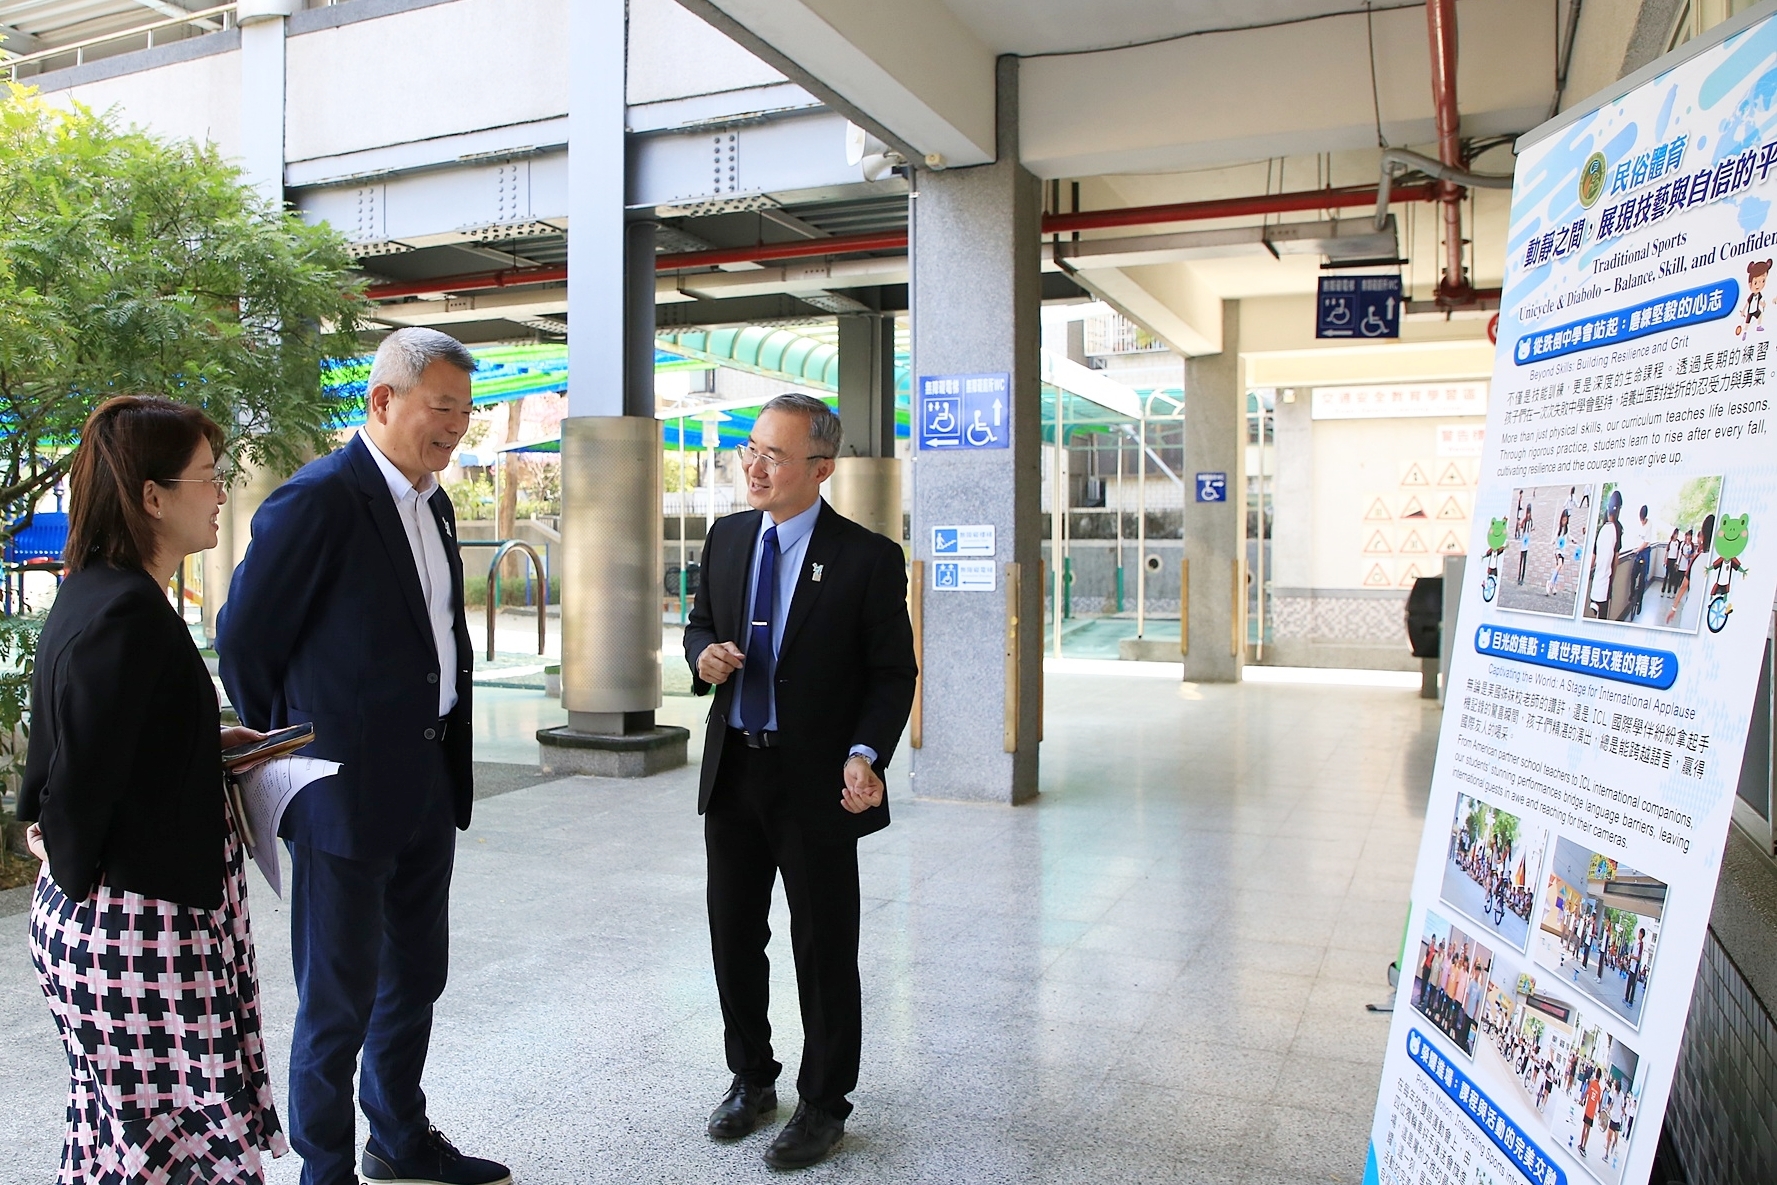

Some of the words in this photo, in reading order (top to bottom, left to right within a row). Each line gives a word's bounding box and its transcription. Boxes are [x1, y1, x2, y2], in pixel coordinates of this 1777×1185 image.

[1610, 134, 1688, 196] 民俗體育
[1593, 243, 1650, 275] Traditional
[1652, 232, 1687, 258] Sports
[1519, 295, 1555, 321] Unicycle
[1557, 293, 1565, 310] &
[1567, 283, 1601, 306] Diabolo
[1614, 271, 1655, 293] Balance,
[1658, 255, 1687, 279] Skill,
[1691, 247, 1717, 269] and
[1530, 367, 1554, 381] Beyond
[1556, 362, 1574, 375] Skills:
[1577, 355, 1608, 369] Building
[1611, 346, 1650, 364] Resilience
[1652, 339, 1668, 354] and
[1671, 335, 1689, 350] Grit
[1500, 449, 1526, 461] Through
[1528, 446, 1554, 460] rigorous
[1556, 441, 1589, 456] practice,
[1593, 438, 1625, 451] students
[1628, 434, 1648, 447] learn
[1652, 432, 1660, 444] to
[1664, 430, 1683, 443] rise
[1687, 427, 1711, 441] after
[1715, 425, 1743, 439] every
[1748, 419, 1766, 435] fall,
[1501, 433, 1517, 443] More
[1520, 431, 1534, 442] than
[1535, 429, 1547, 442] just
[1549, 423, 1578, 439] physical
[1581, 421, 1603, 434] skills,
[1607, 421, 1619, 432] our
[1621, 412, 1662, 430] curriculum
[1666, 408, 1705, 423] teaches
[1709, 404, 1723, 418] life
[1728, 399, 1771, 415] lessons.
[1497, 464, 1527, 477] cultivating
[1528, 463, 1556, 474] resilience
[1558, 460, 1571, 472] and
[1573, 460, 1584, 470] the
[1587, 458, 1615, 471] courage
[1617, 456, 1624, 467] to
[1625, 454, 1647, 466] never
[1648, 452, 1666, 467] give
[1669, 452, 1682, 465] up.
[1492, 632, 1664, 679] 目光的焦點：讓世界看見文雅的精彩
[1488, 663, 1520, 683] Captivating
[1523, 671, 1532, 682] the
[1535, 673, 1558, 689] World:
[1559, 679, 1565, 690] A
[1567, 680, 1586, 697] Stage
[1589, 684, 1597, 697] for
[1599, 686, 1652, 710] International
[1653, 699, 1695, 720] Applause
[1593, 709, 1607, 726] ICL
[1612, 713, 1709, 753] 國際學伴紛紛拿起手
[1452, 766, 1484, 785] international
[1485, 780, 1502, 796] guests
[1504, 787, 1510, 798] in
[1511, 792, 1524, 805] awe
[1526, 798, 1539, 810] and
[1540, 802, 1567, 825] reaching
[1567, 812, 1579, 826] for
[1577, 817, 1592, 833] their
[1593, 826, 1628, 849] cameras.
[1455, 753, 1464, 762] our
[1491, 765, 1516, 786] stunning
[1517, 776, 1561, 800] performances
[1564, 790, 1583, 810] bridge
[1585, 799, 1619, 825] language
[1622, 813, 1655, 839] barriers,
[1659, 826, 1690, 854] leaving
[1457, 734, 1472, 747] From
[1472, 740, 1497, 757] American
[1498, 751, 1520, 765] partner
[1521, 758, 1543, 773] school
[1543, 764, 1571, 784] teachers
[1571, 774, 1578, 786] to
[1579, 775, 1590, 791] ICL
[1593, 781, 1640, 808] international
[1642, 800, 1693, 830] companions,
[1455, 1114, 1485, 1157] Integrating
[1486, 1148, 1505, 1177] Sports
